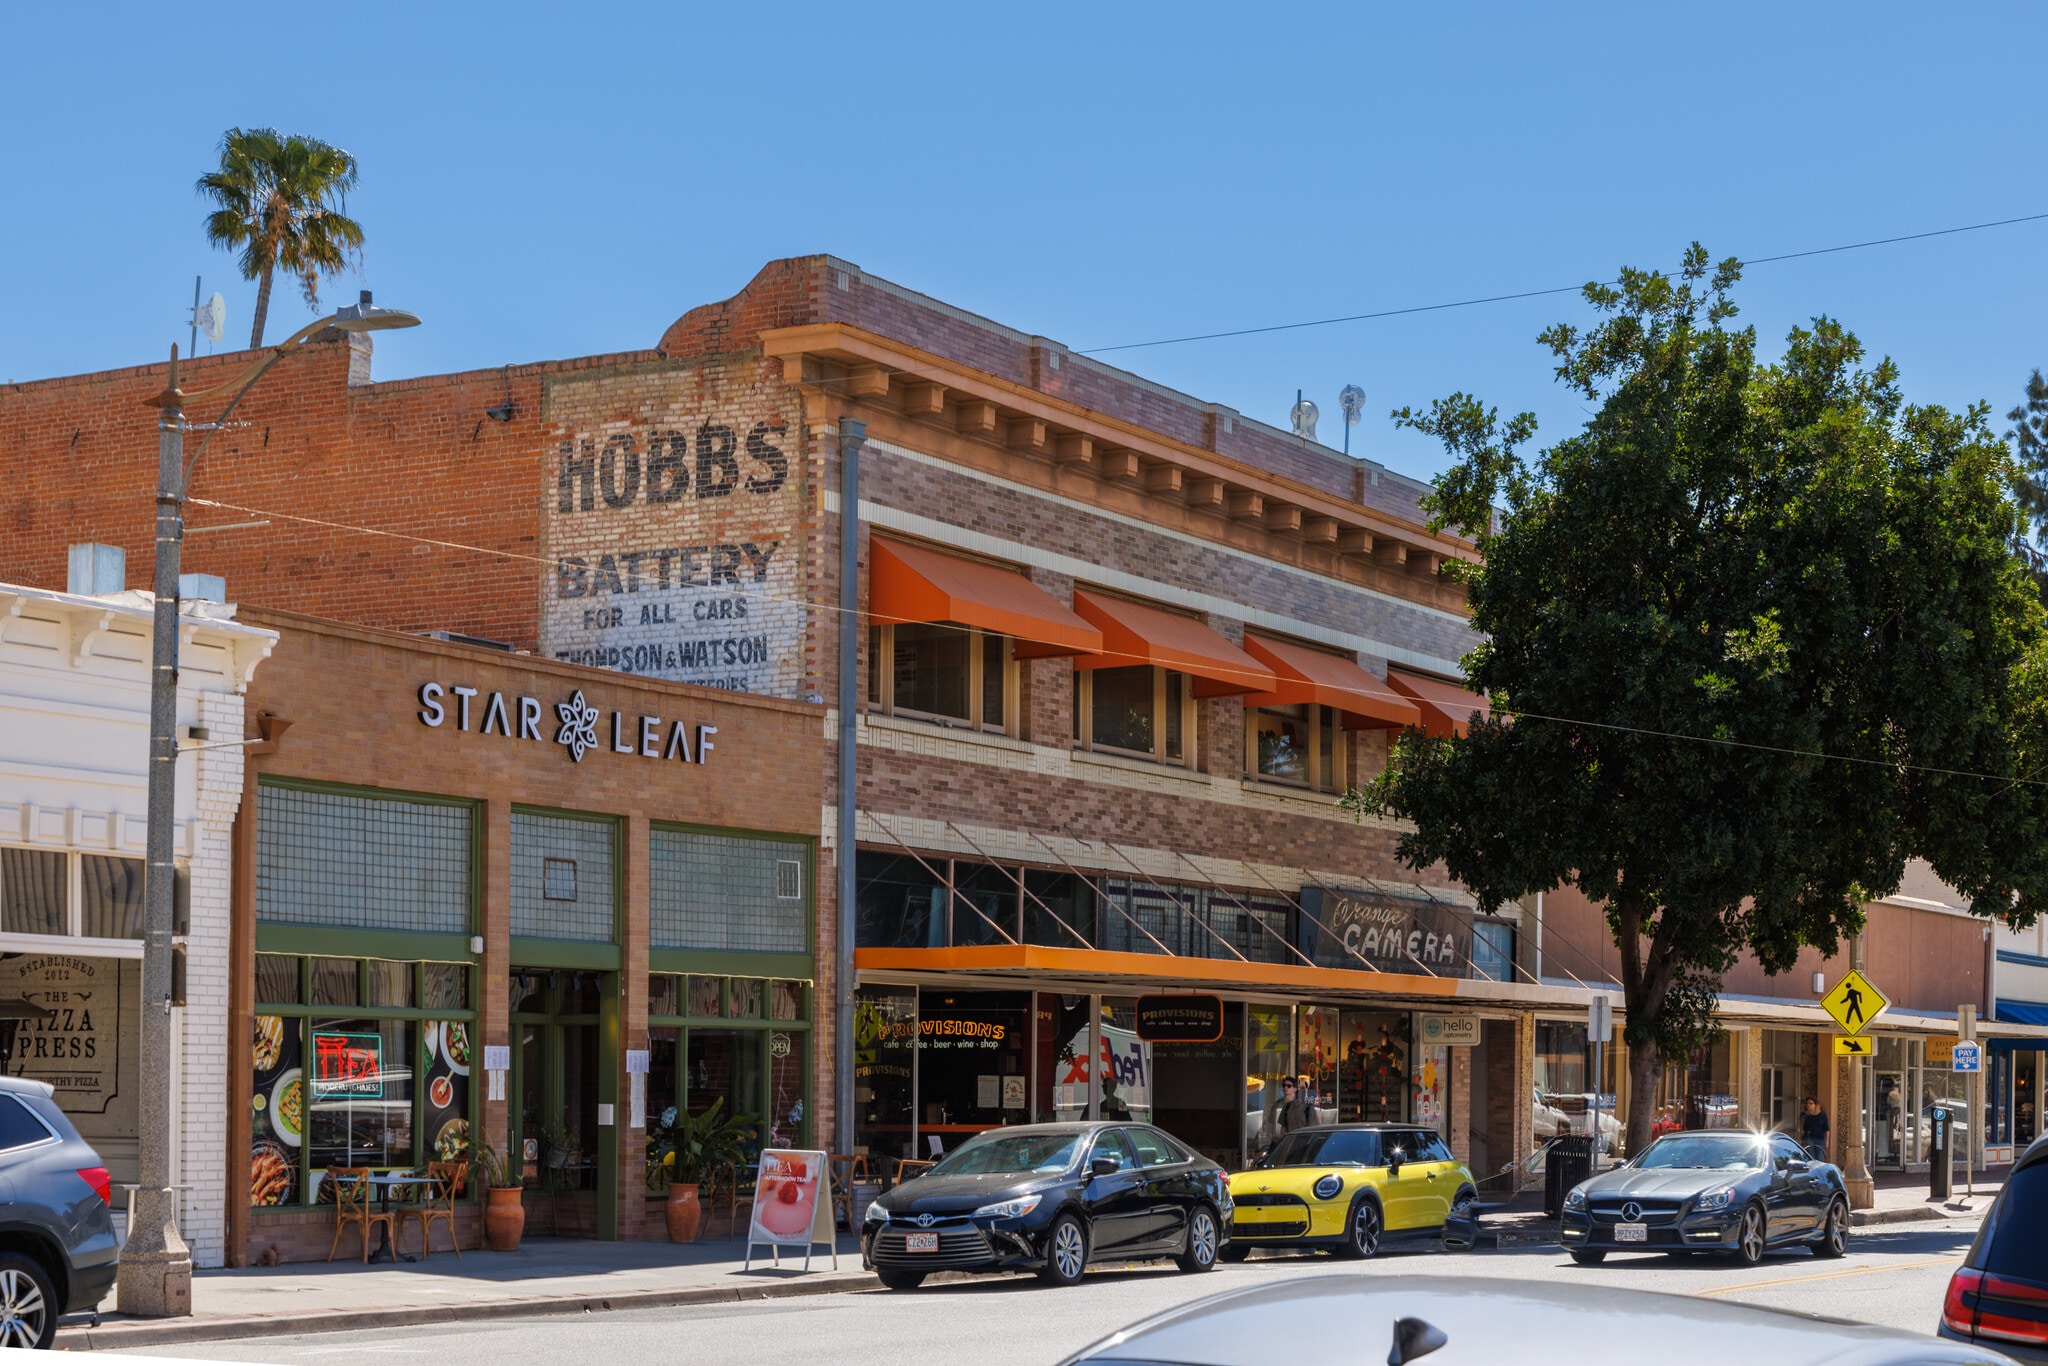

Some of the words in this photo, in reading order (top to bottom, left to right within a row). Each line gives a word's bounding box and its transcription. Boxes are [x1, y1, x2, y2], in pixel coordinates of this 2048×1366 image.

[557, 419, 790, 513] HOBBS
[557, 541, 779, 598] BATTERY
[583, 606, 623, 630] FOR
[640, 603, 676, 625] ALL
[693, 596, 747, 622] CARS
[665, 650, 676, 668] &
[678, 636, 767, 666] WATSON
[417, 682, 542, 741] STAR
[610, 711, 718, 764] LEAF
[1331, 898, 1409, 938] Orange
[1344, 923, 1455, 964] CAMERA
[19, 956, 95, 977] ESTABLISHED
[45, 969, 70, 980] 2012
[44, 991, 68, 1002] THE
[1142, 1008, 1215, 1020] PROVISIONS
[878, 1020, 1005, 1040] PROVISIONS
[1443, 1018, 1473, 1031] hello
[18, 1037, 96, 1058] PRESS
[884, 1040, 900, 1048] cafe
[933, 1039, 952, 1048] beer
[957, 1040, 974, 1048] wine
[980, 1039, 998, 1050] shop
[1958, 1049, 1974, 1057] PAY
[1955, 1056, 1977, 1064] HERE
[74, 1076, 99, 1086] PIZZA
[856, 1065, 911, 1078] PROVISIONS
[1416, 1094, 1441, 1116] hello
